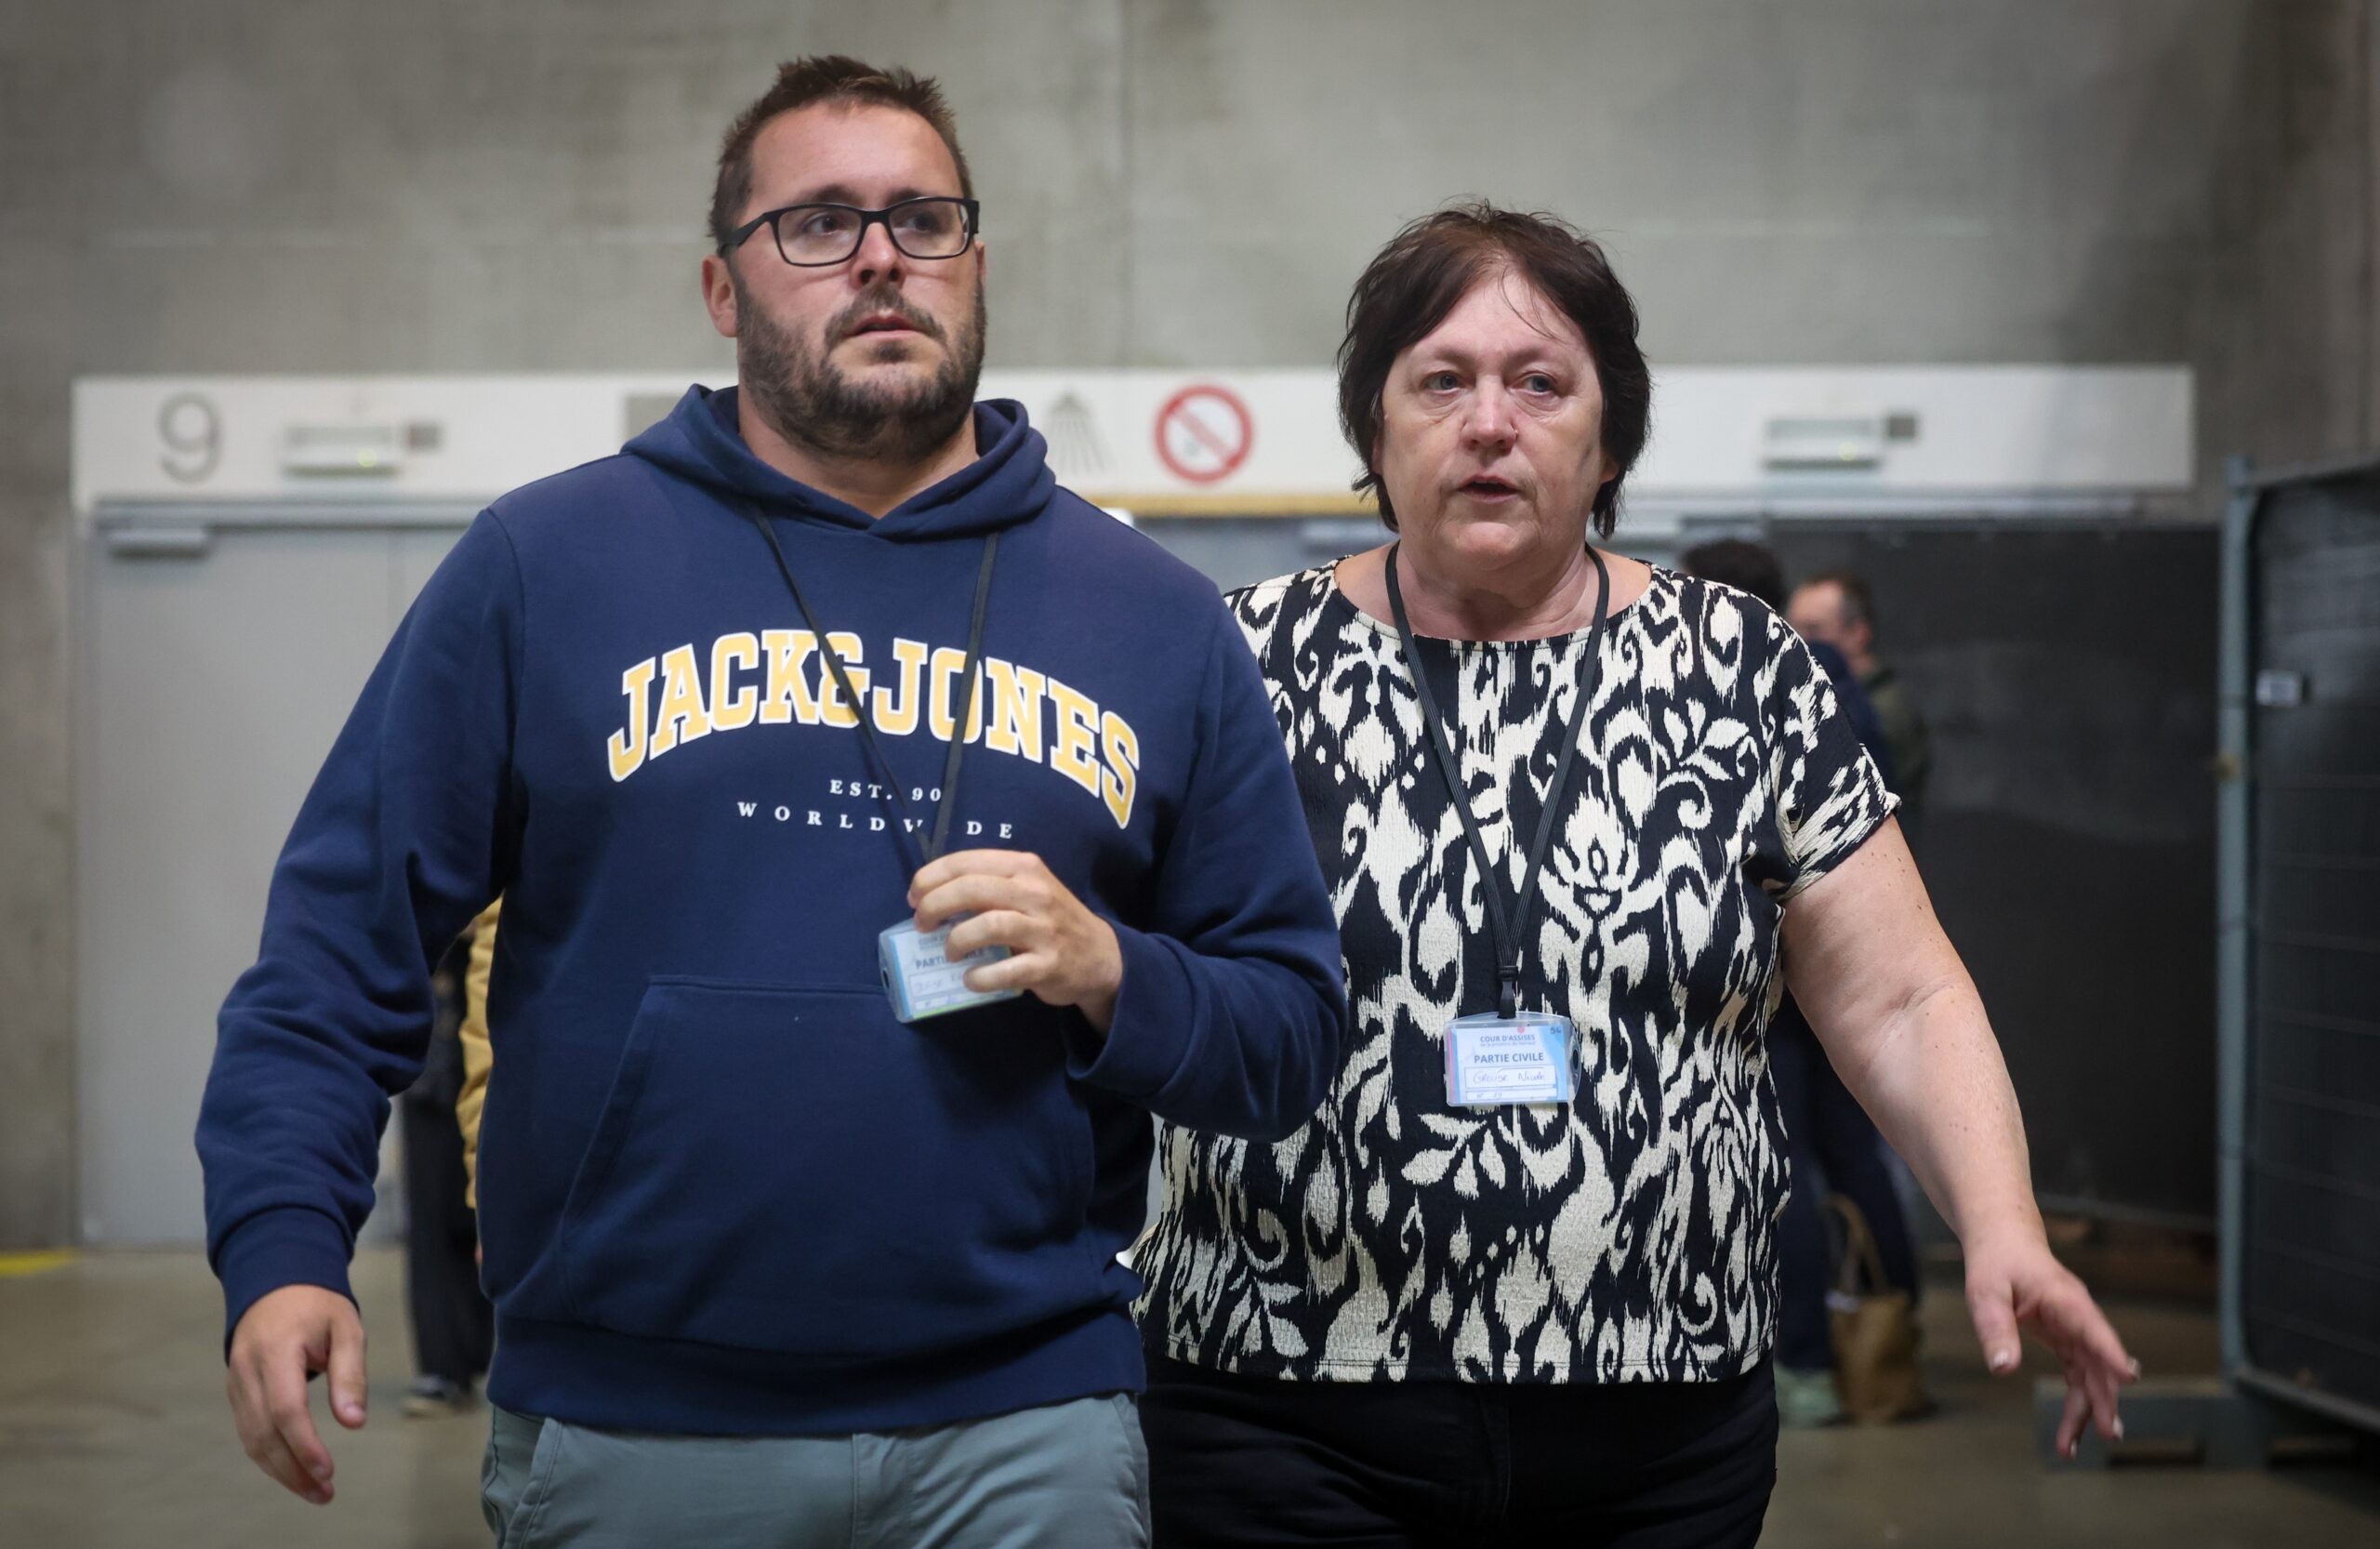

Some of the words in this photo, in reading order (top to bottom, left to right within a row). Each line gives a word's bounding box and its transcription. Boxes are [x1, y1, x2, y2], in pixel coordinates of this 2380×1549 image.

[158, 391, 220, 483] 9
[829, 778, 893, 801] EST.
[736, 801, 1013, 840] WORLDWDE
[915, 955, 946, 970] PARTI
[1501, 1034, 1536, 1042] D'ASSISES
[1474, 1053, 1510, 1064] PARTIE
[1512, 1053, 1544, 1063] CIVILE
